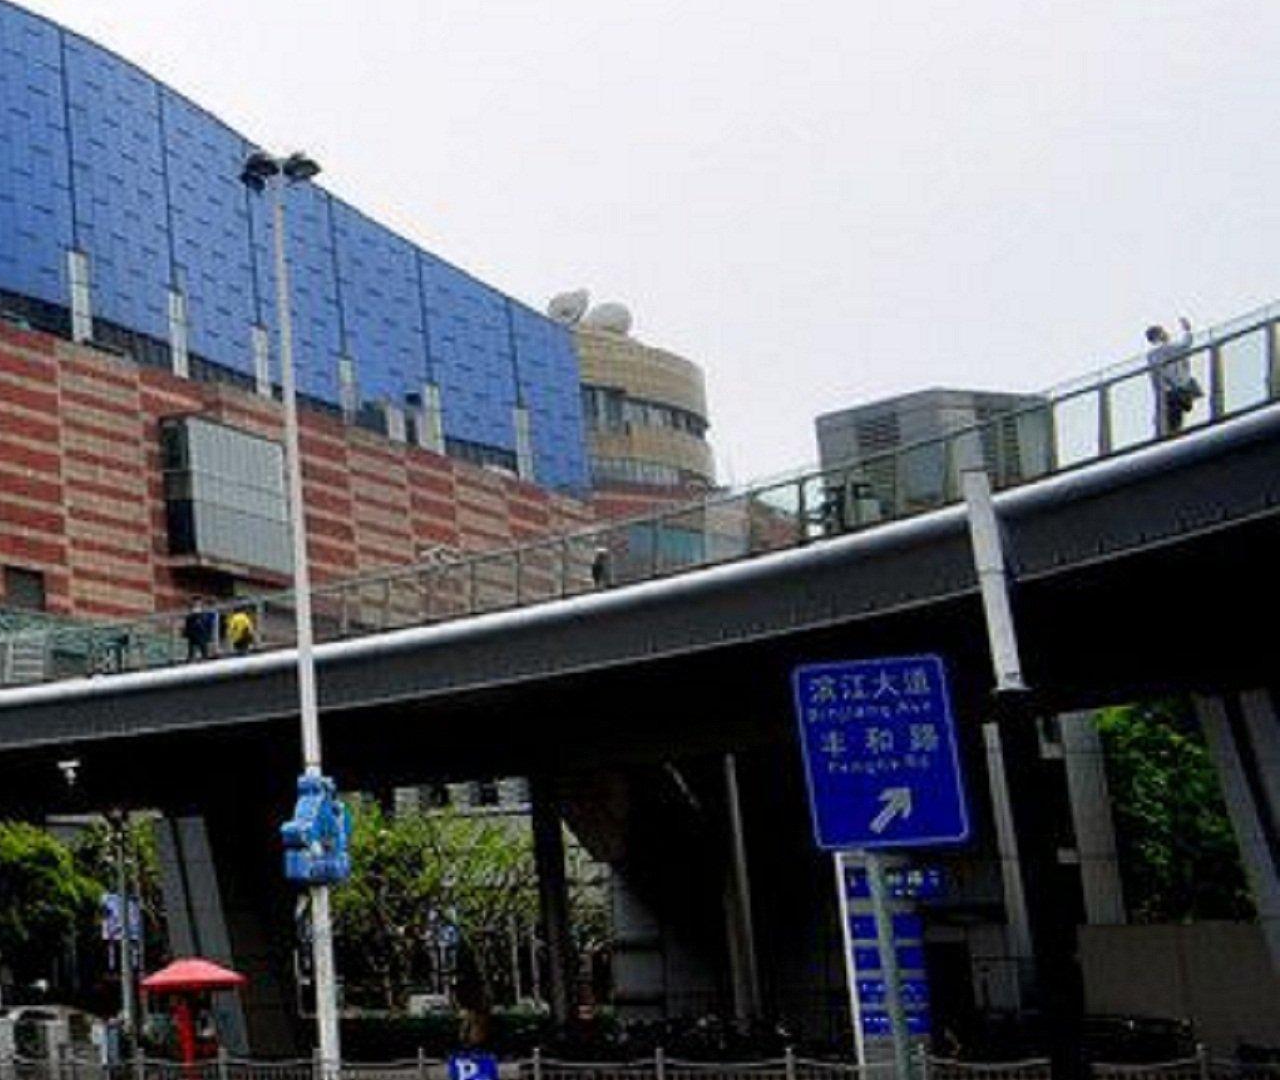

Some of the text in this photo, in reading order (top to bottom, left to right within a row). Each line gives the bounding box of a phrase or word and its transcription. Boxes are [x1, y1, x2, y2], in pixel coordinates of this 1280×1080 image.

[808, 667, 931, 703] 滨江大道
[820, 723, 939, 758] 丰和路
